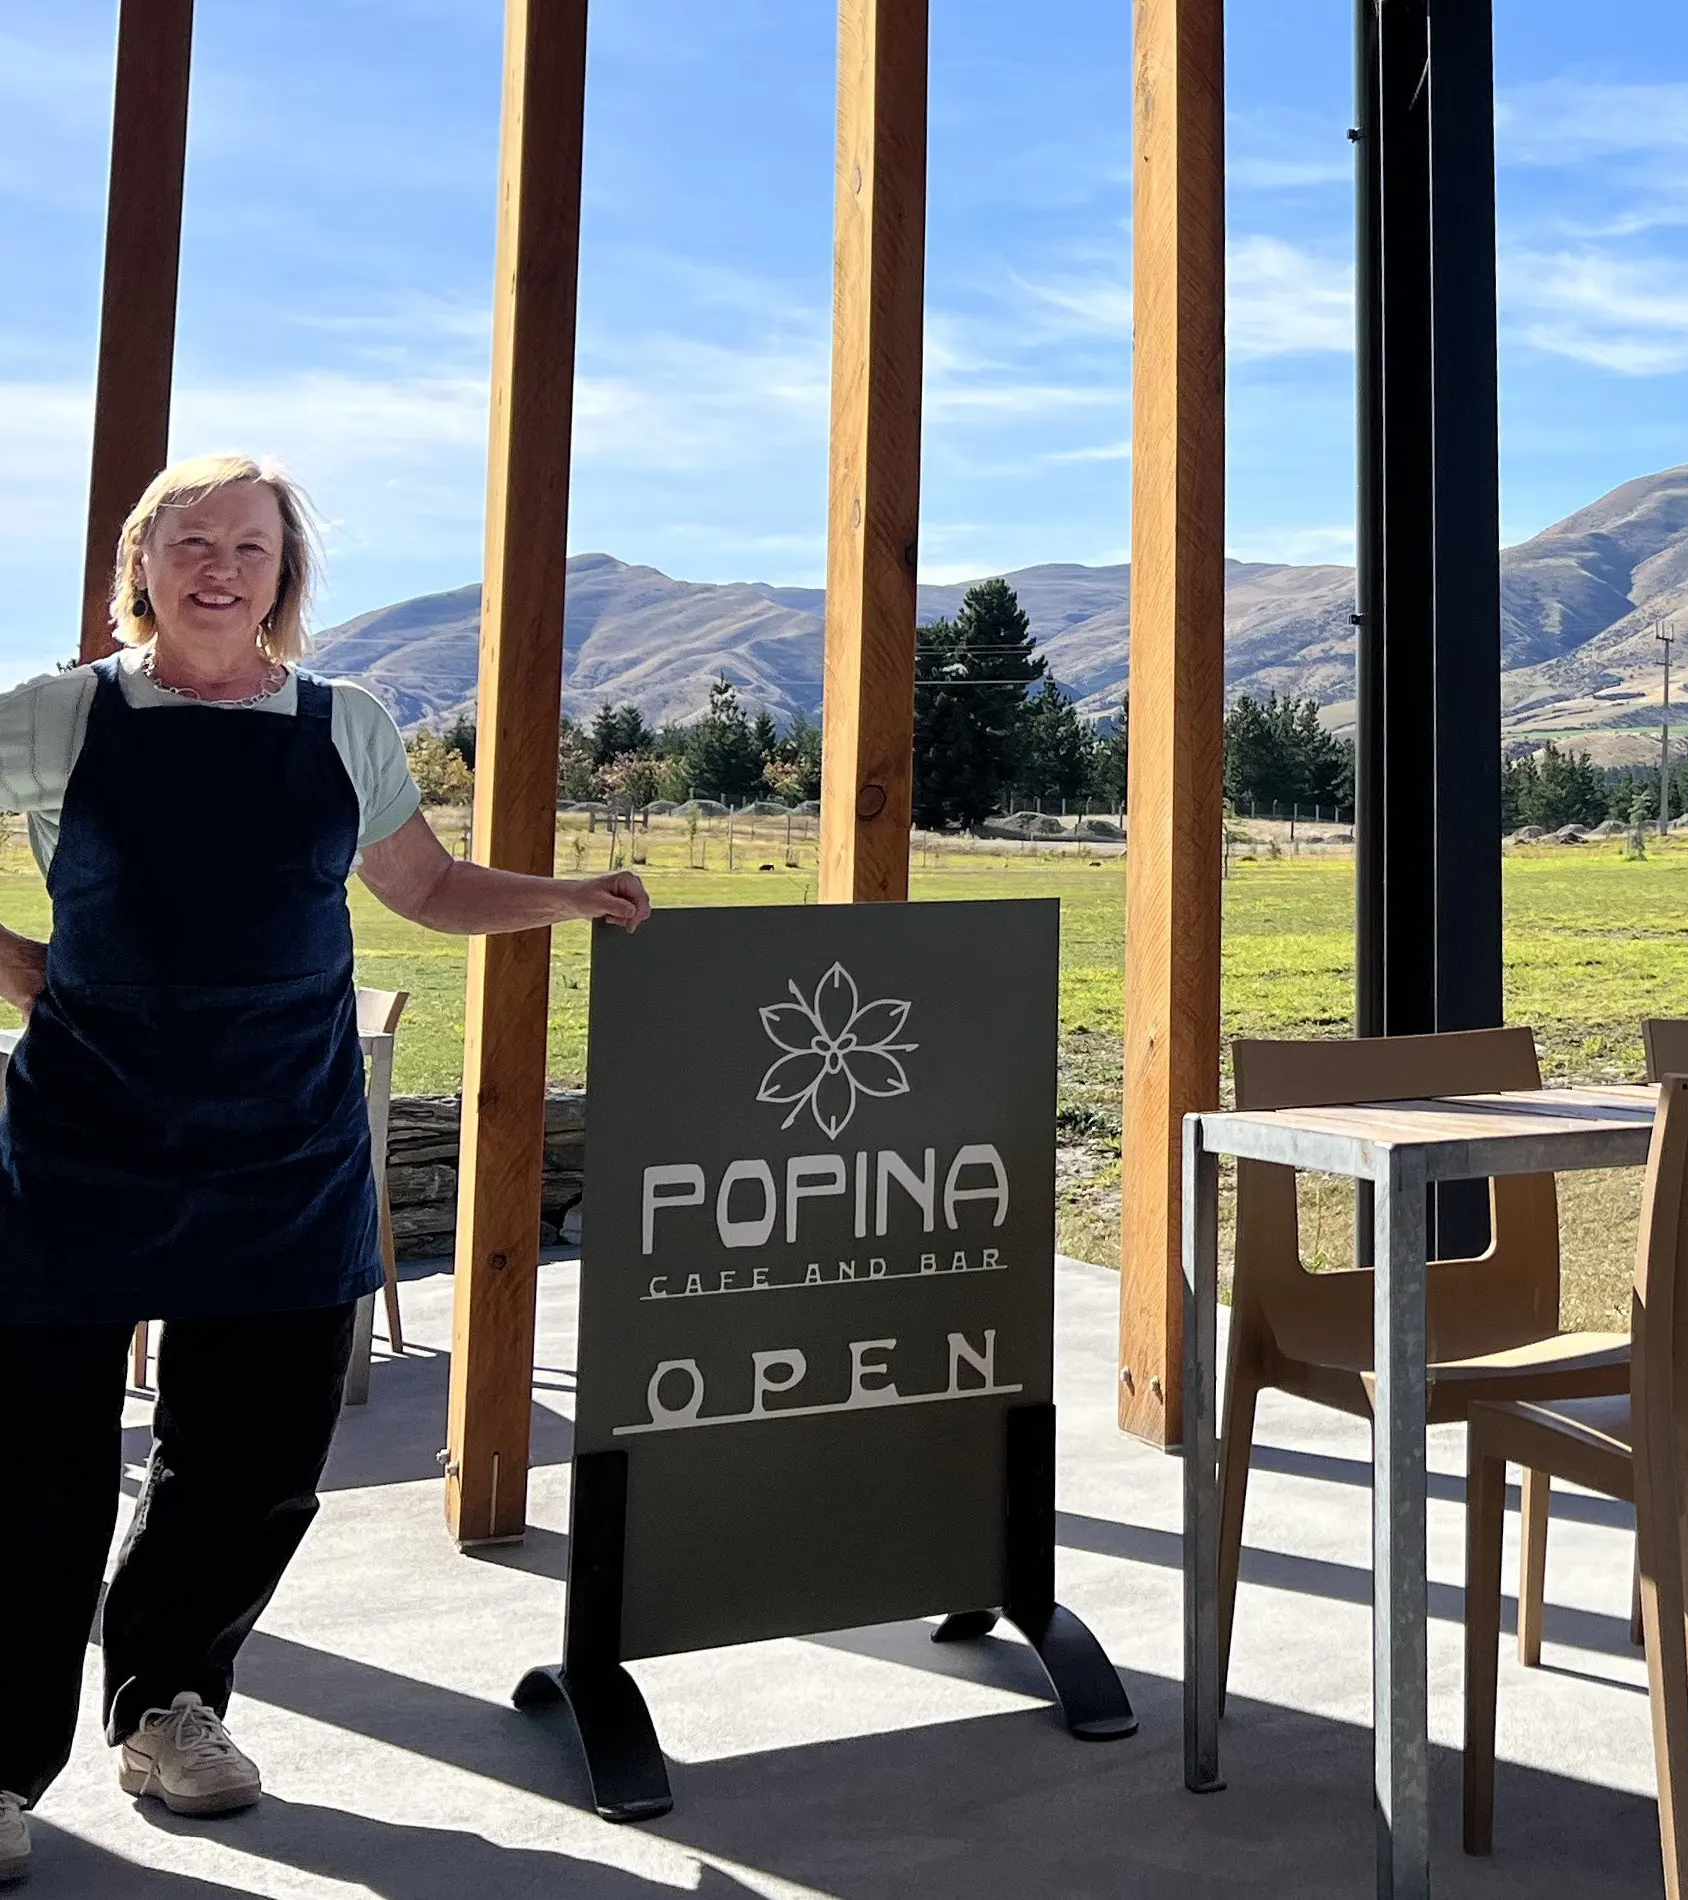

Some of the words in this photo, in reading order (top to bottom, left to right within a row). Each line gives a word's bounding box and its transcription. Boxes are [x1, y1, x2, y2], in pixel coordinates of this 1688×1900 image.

[641, 1144, 1009, 1255] POPINA
[649, 1267, 770, 1297] CAFE
[804, 1256, 887, 1284] AND
[919, 1248, 1001, 1273] BAR
[646, 1328, 997, 1423] OPEN
